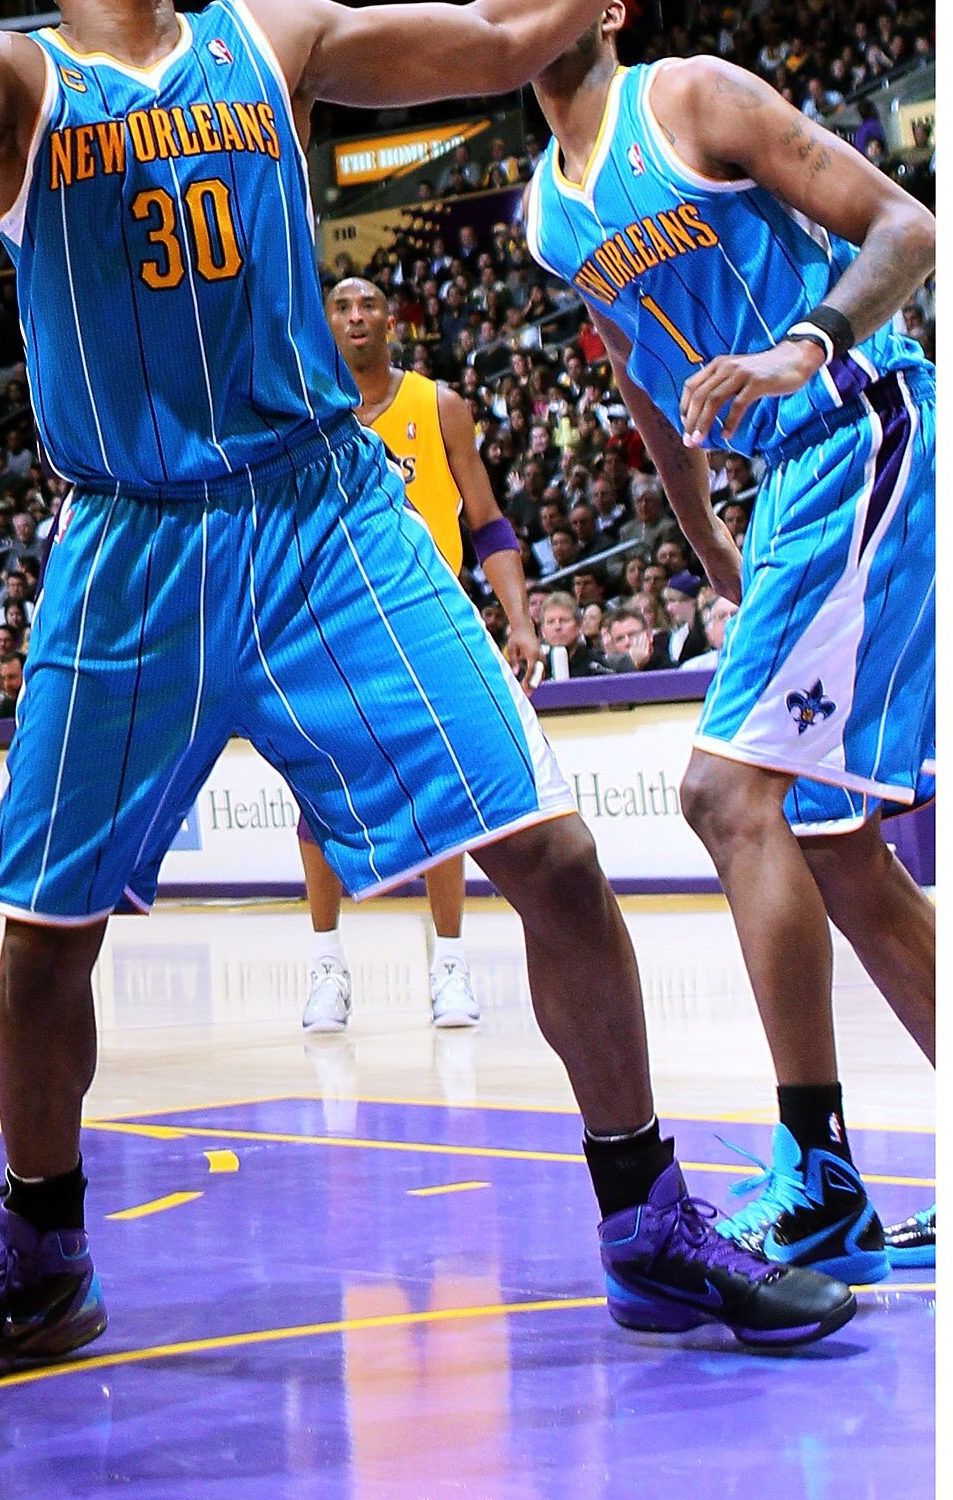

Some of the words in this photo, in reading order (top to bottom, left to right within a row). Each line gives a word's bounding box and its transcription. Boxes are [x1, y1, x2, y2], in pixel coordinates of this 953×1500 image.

[50, 121, 126, 191] NEW
[126, 101, 281, 164] ORLEANS
[131, 177, 244, 290] 30
[593, 202, 720, 290] ORLEANS
[640, 295, 705, 366] 1
[208, 787, 297, 830] Health
[571, 768, 681, 817] Health
